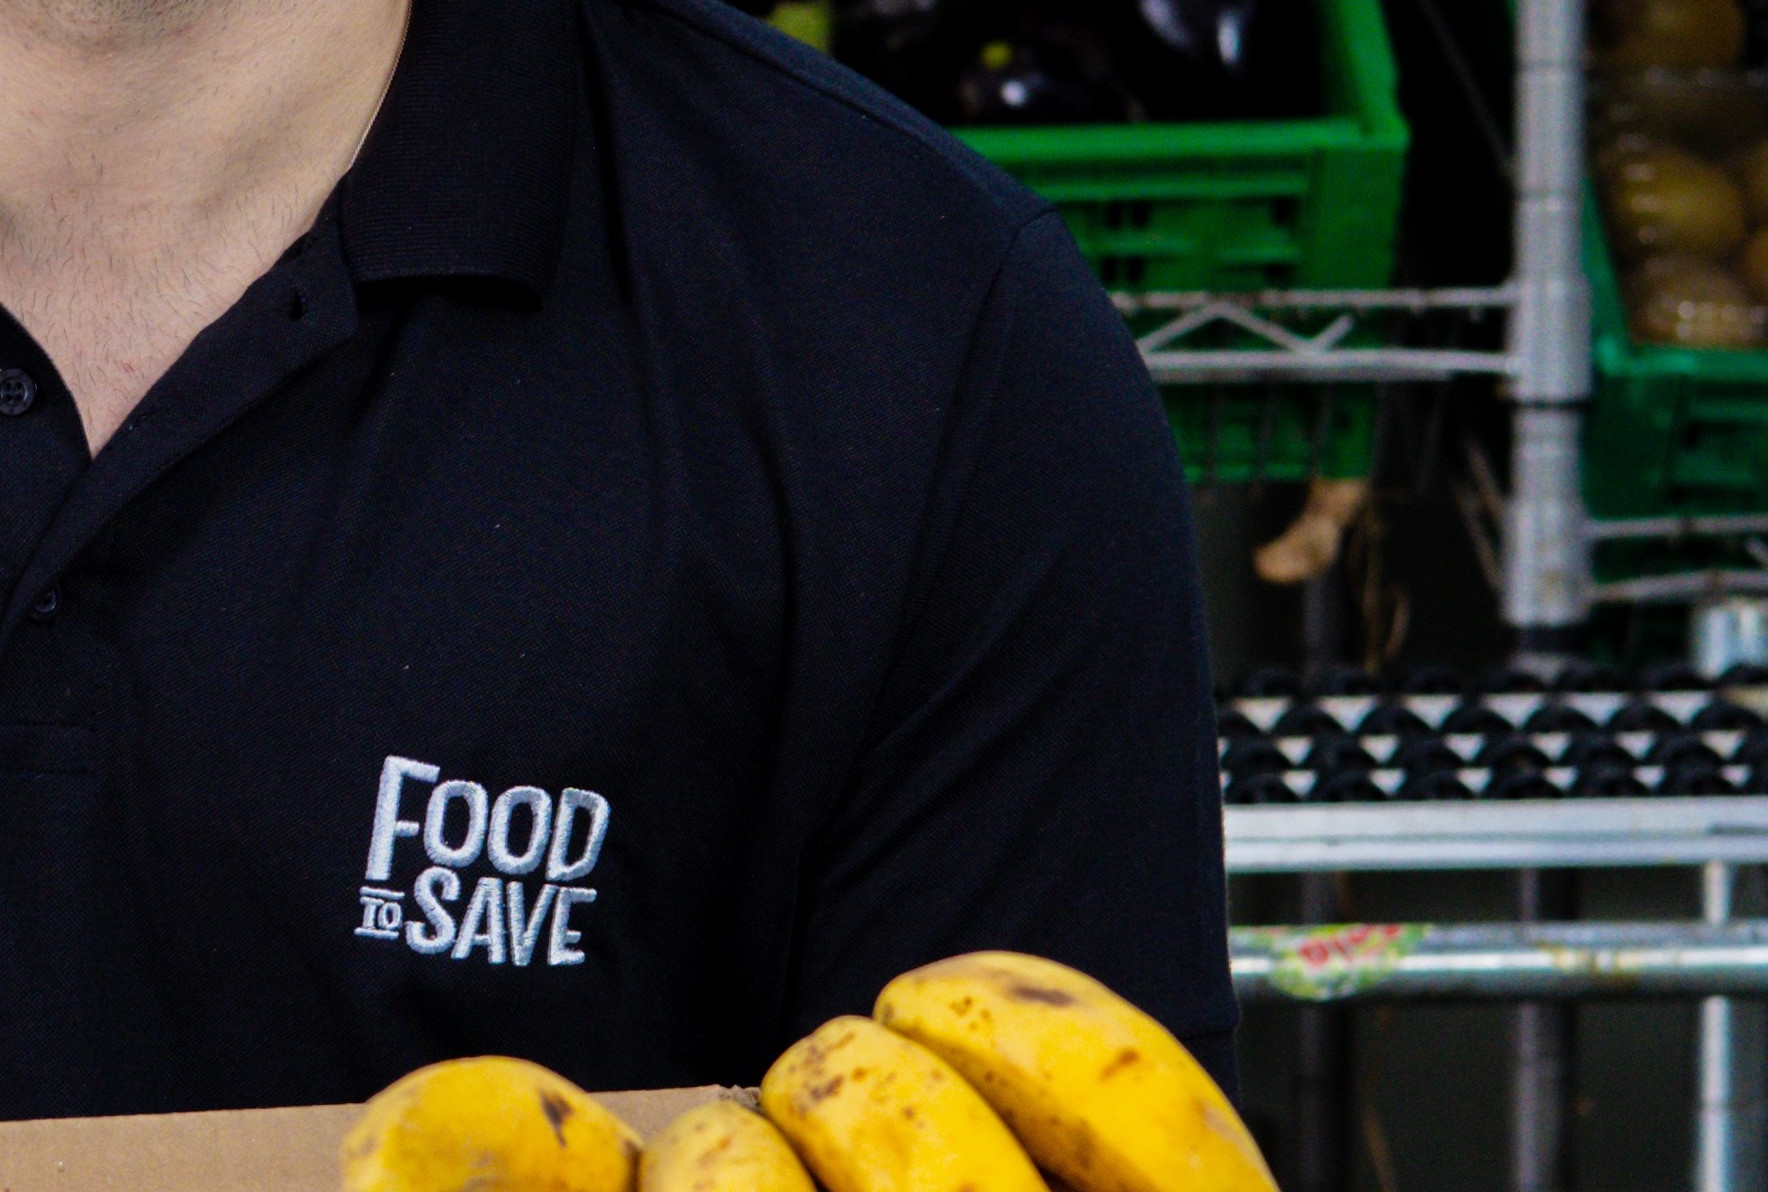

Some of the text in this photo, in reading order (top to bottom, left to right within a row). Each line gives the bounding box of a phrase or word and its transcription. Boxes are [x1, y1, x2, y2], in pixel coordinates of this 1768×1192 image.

[365, 755, 610, 881] FOOD
[355, 865, 597, 966] TO SAVE
